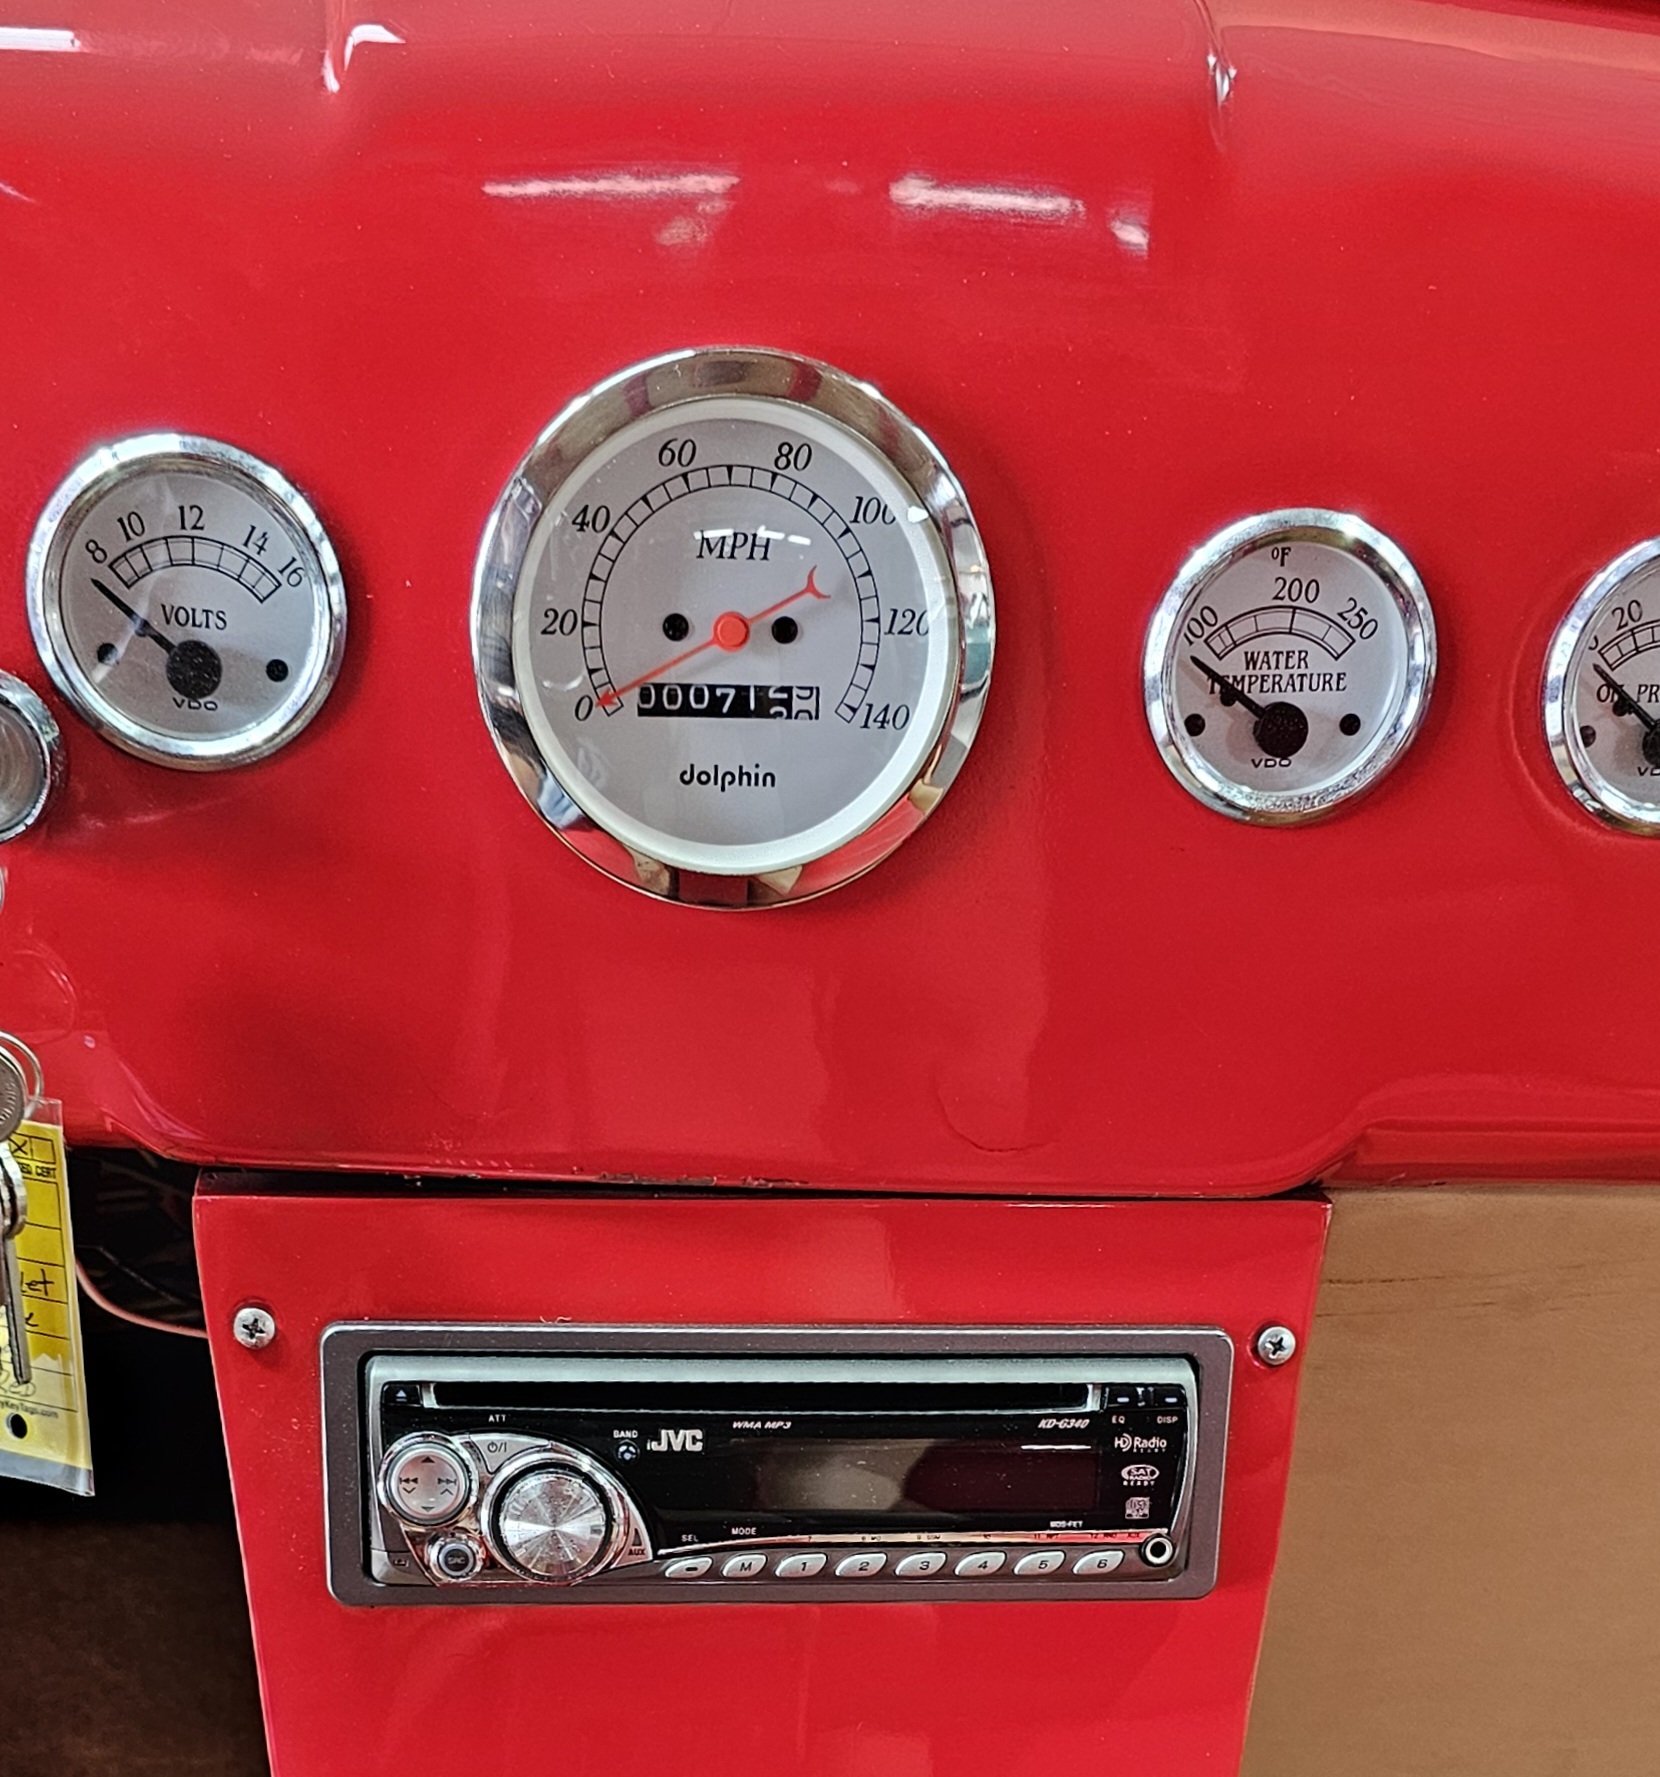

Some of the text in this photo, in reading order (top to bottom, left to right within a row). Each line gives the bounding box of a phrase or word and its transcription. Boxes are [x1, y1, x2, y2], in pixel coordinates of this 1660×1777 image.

[658, 438, 697, 468] 60
[774, 442, 812, 472] 80
[117, 511, 145, 542] 10
[178, 504, 205, 531] 12
[571, 505, 611, 534] 40
[243, 525, 270, 556] 14
[696, 530, 773, 562] MPH
[85, 539, 108, 564] 8
[278, 557, 306, 588] 16
[1272, 576, 1320, 604] 200
[161, 603, 227, 631] VOLTS
[540, 608, 578, 637] 20
[1336, 598, 1379, 641] 250
[1612, 600, 1644, 631] 20
[1183, 605, 1219, 647] 100
[1244, 650, 1310, 671] WATER
[172, 697, 219, 713] VDO
[574, 695, 595, 722] 0
[859, 703, 911, 731] 140
[1251, 757, 1293, 770] VDO
[679, 763, 777, 792] dolphin
[488, 1414, 507, 1423] ATT
[732, 1421, 792, 1430] WMA MP3
[1037, 1418, 1090, 1429] KD-G340
[1111, 1415, 1126, 1425] EQ
[1156, 1416, 1179, 1424] DISP
[613, 1429, 639, 1439] BAND
[651, 1429, 703, 1452] JVC
[1133, 1436, 1168, 1449] Radio
[1130, 1468, 1153, 1477] SAT
[682, 1534, 699, 1543] SEL
[731, 1527, 757, 1535] MODE
[628, 1548, 646, 1557] AUX
[740, 1562, 752, 1572] M
[801, 1561, 808, 1572] 1
[858, 1561, 870, 1572] 2
[919, 1560, 930, 1571] 3
[977, 1560, 989, 1570] 4
[1038, 1560, 1049, 1570] 5
[1097, 1559, 1108, 1569] 6
